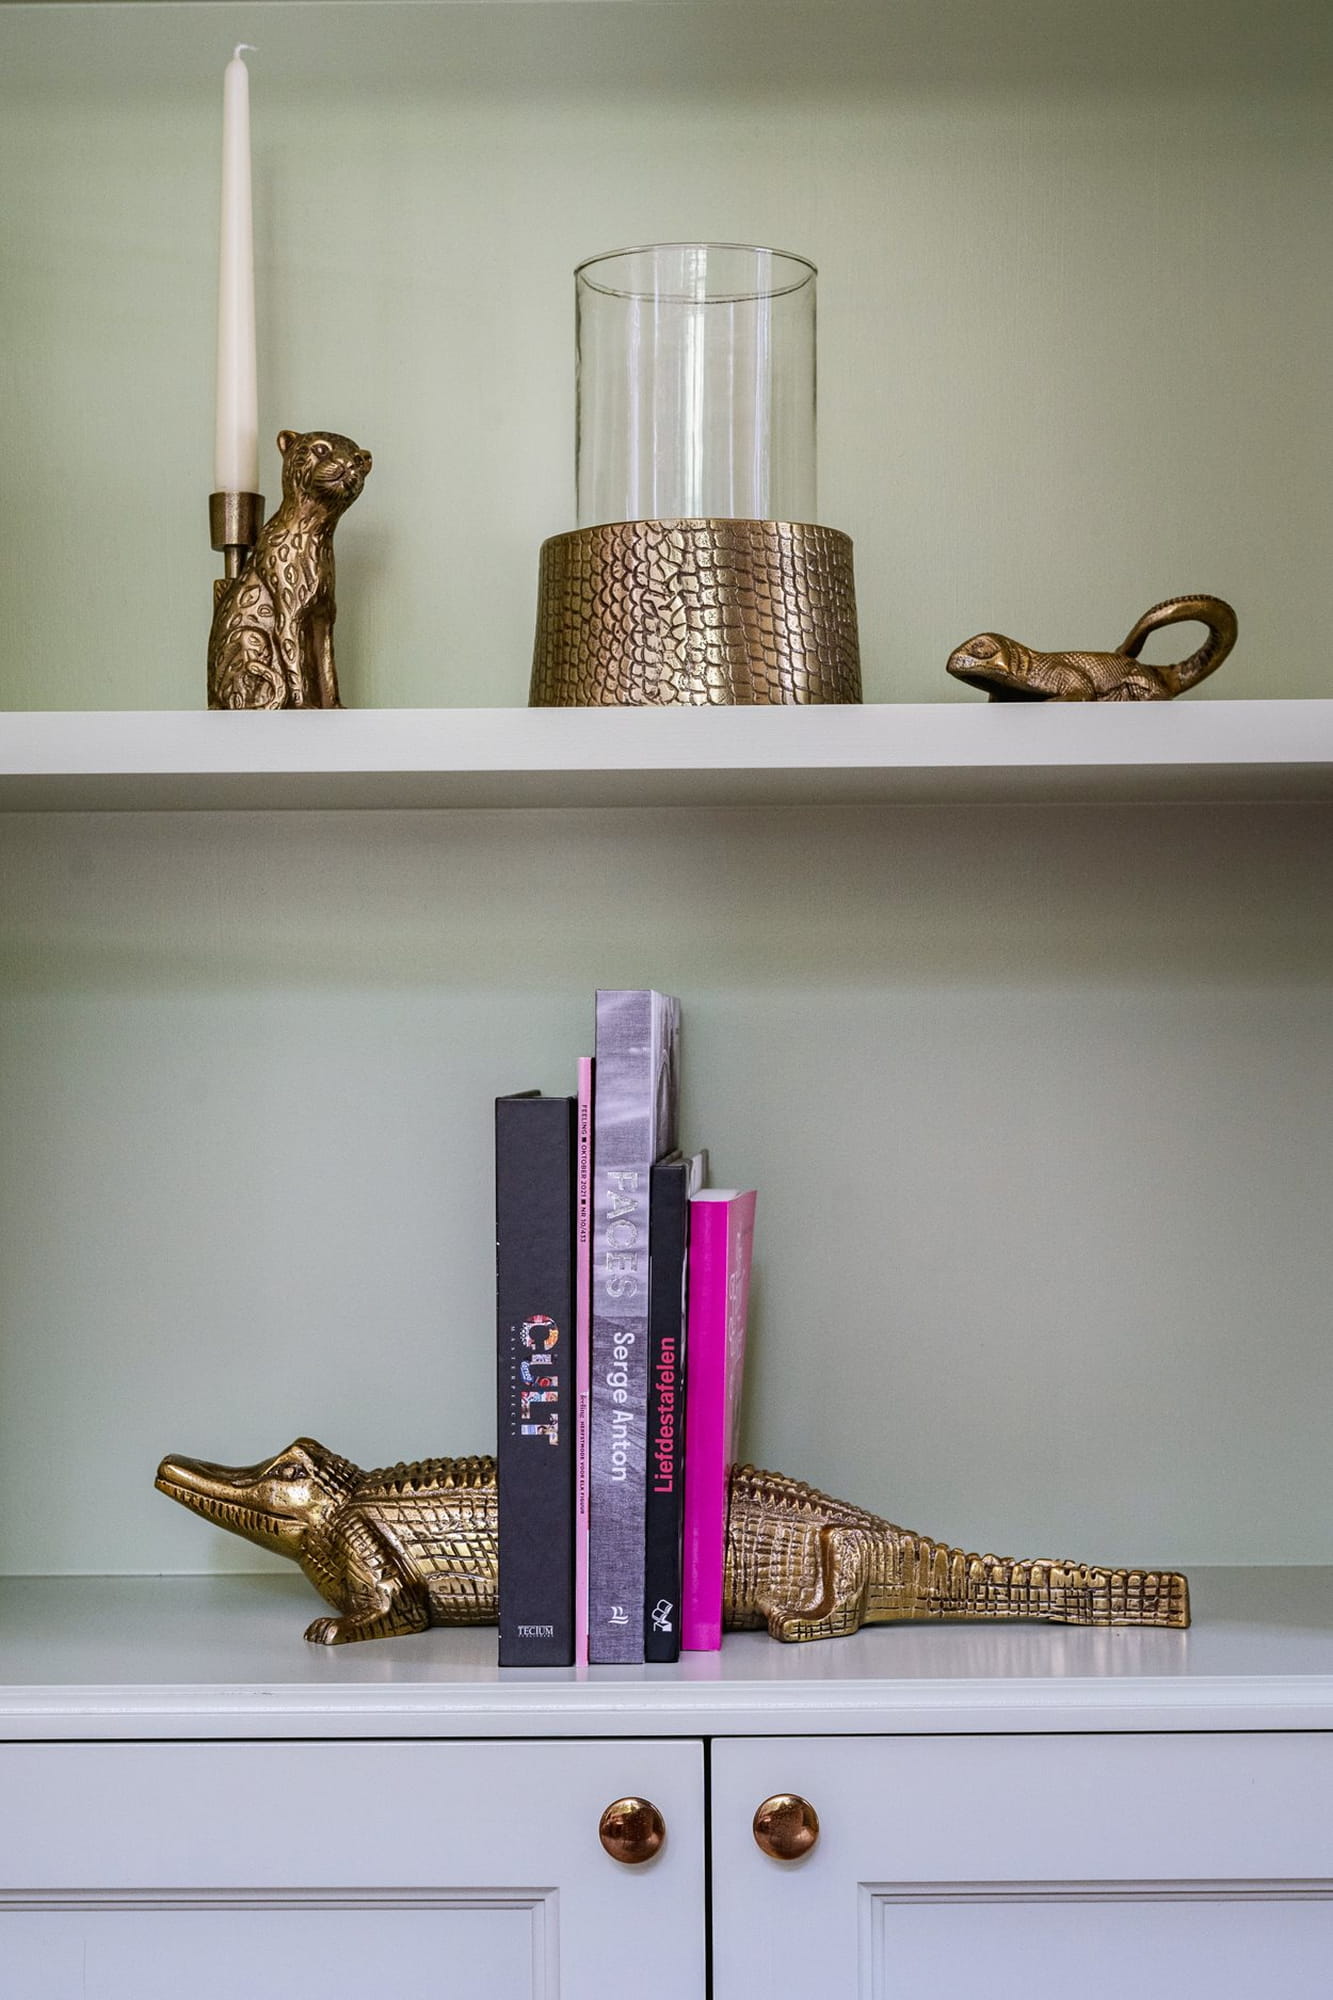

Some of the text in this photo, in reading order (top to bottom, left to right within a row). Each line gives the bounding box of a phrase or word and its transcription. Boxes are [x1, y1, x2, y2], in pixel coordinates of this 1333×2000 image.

[580, 1207, 587, 1217] NR
[605, 1170, 640, 1298] FACES
[519, 1314, 560, 1446] CULT
[606, 1332, 635, 1481] Serge Anton
[653, 1337, 675, 1493] Liefdestafelen
